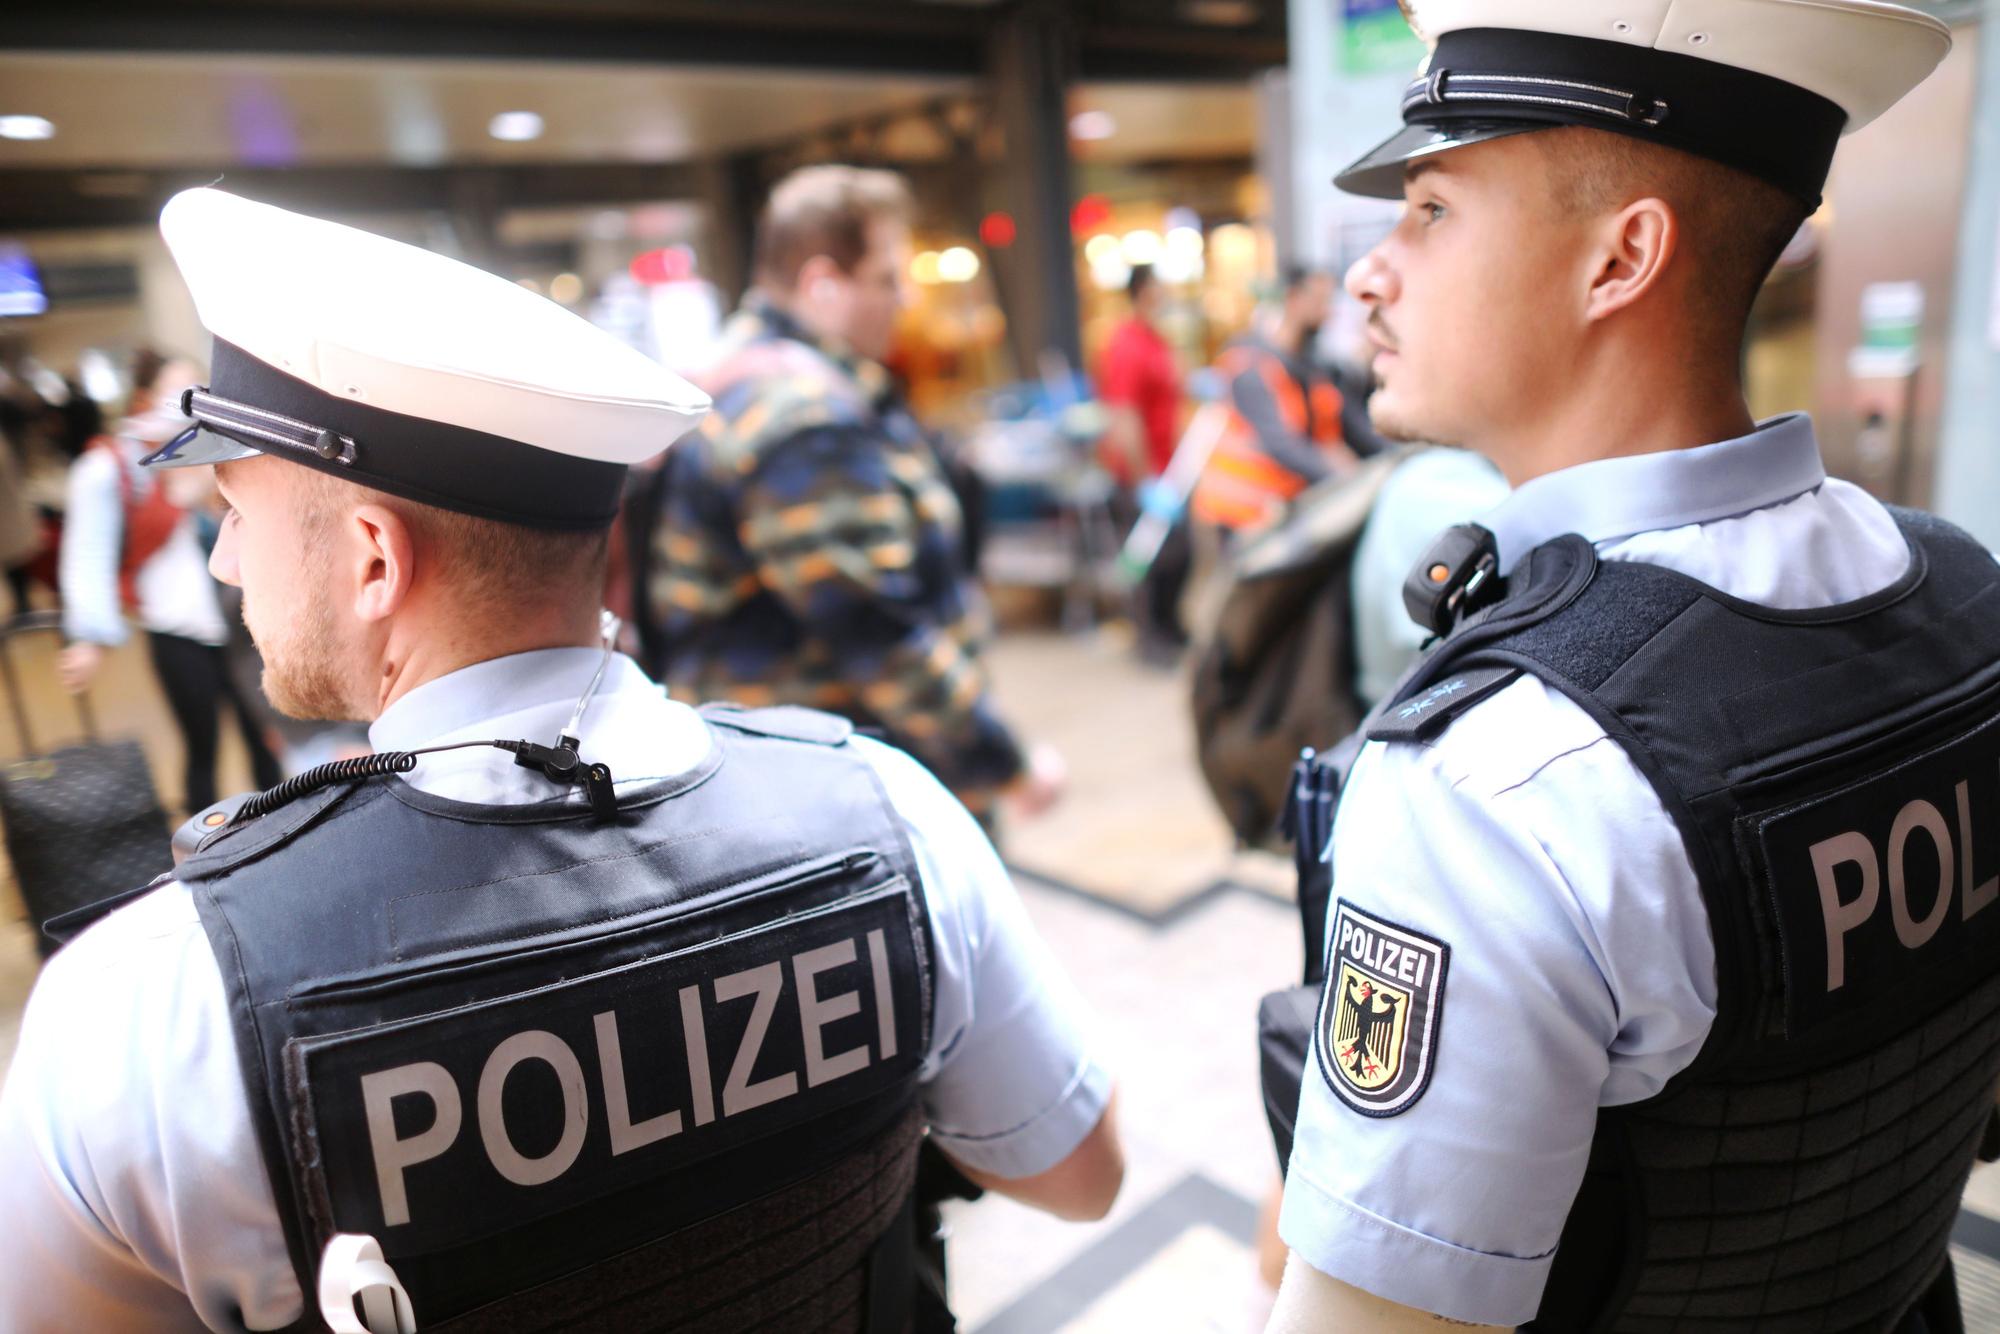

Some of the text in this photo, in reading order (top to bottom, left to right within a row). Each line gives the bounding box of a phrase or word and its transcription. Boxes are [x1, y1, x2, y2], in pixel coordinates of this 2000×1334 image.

[1339, 919, 1428, 988] POLIZEI
[1808, 756, 2000, 993] POL
[361, 928, 897, 1227] POLIZEI
